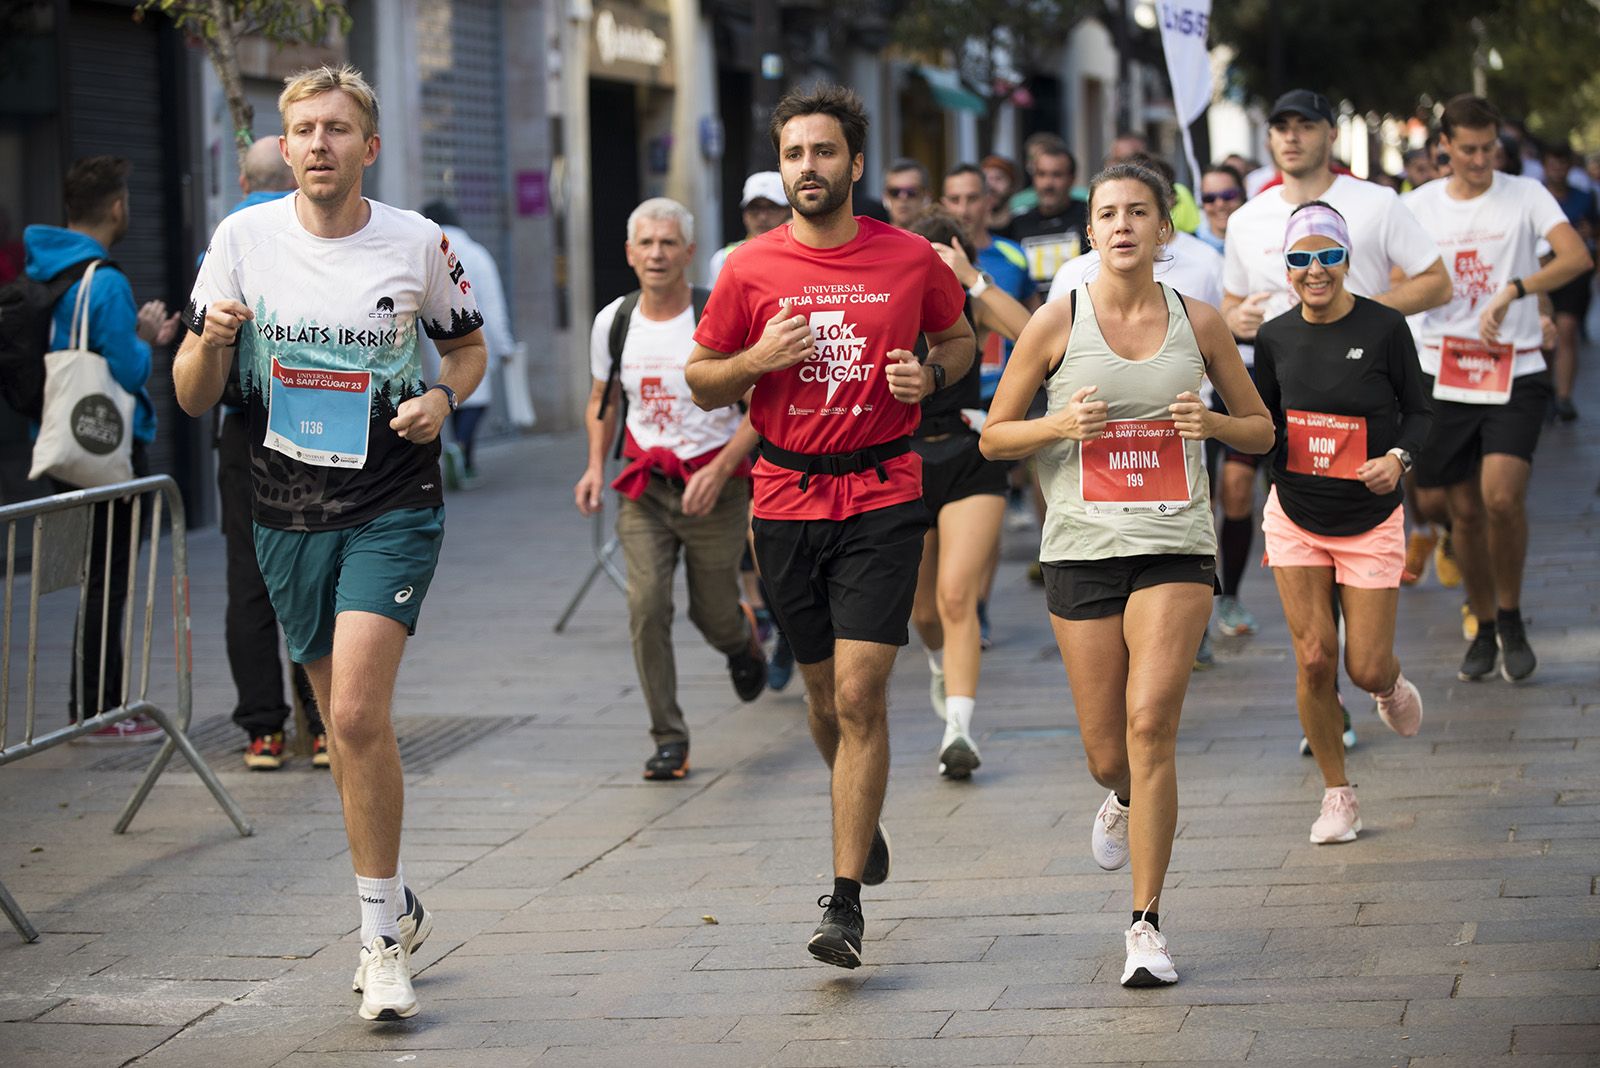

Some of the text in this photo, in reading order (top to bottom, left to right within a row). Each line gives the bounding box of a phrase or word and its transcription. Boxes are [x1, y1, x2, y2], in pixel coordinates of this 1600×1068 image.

[803, 284, 865, 294] UNIVERSAE
[816, 294, 848, 305] SANT
[849, 293, 890, 303] CUGAT
[815, 323, 857, 341] 10K
[798, 364, 875, 383] CUGAT
[296, 378, 319, 386] SANT
[320, 380, 350, 389] CUGAT
[351, 382, 362, 390] 23
[300, 421, 323, 434] 1136
[1115, 430, 1136, 438] SANT
[1137, 429, 1165, 437] CUGAT
[1309, 437, 1336, 455] MON
[1109, 451, 1160, 470] MARINA
[1126, 474, 1144, 487] 199
